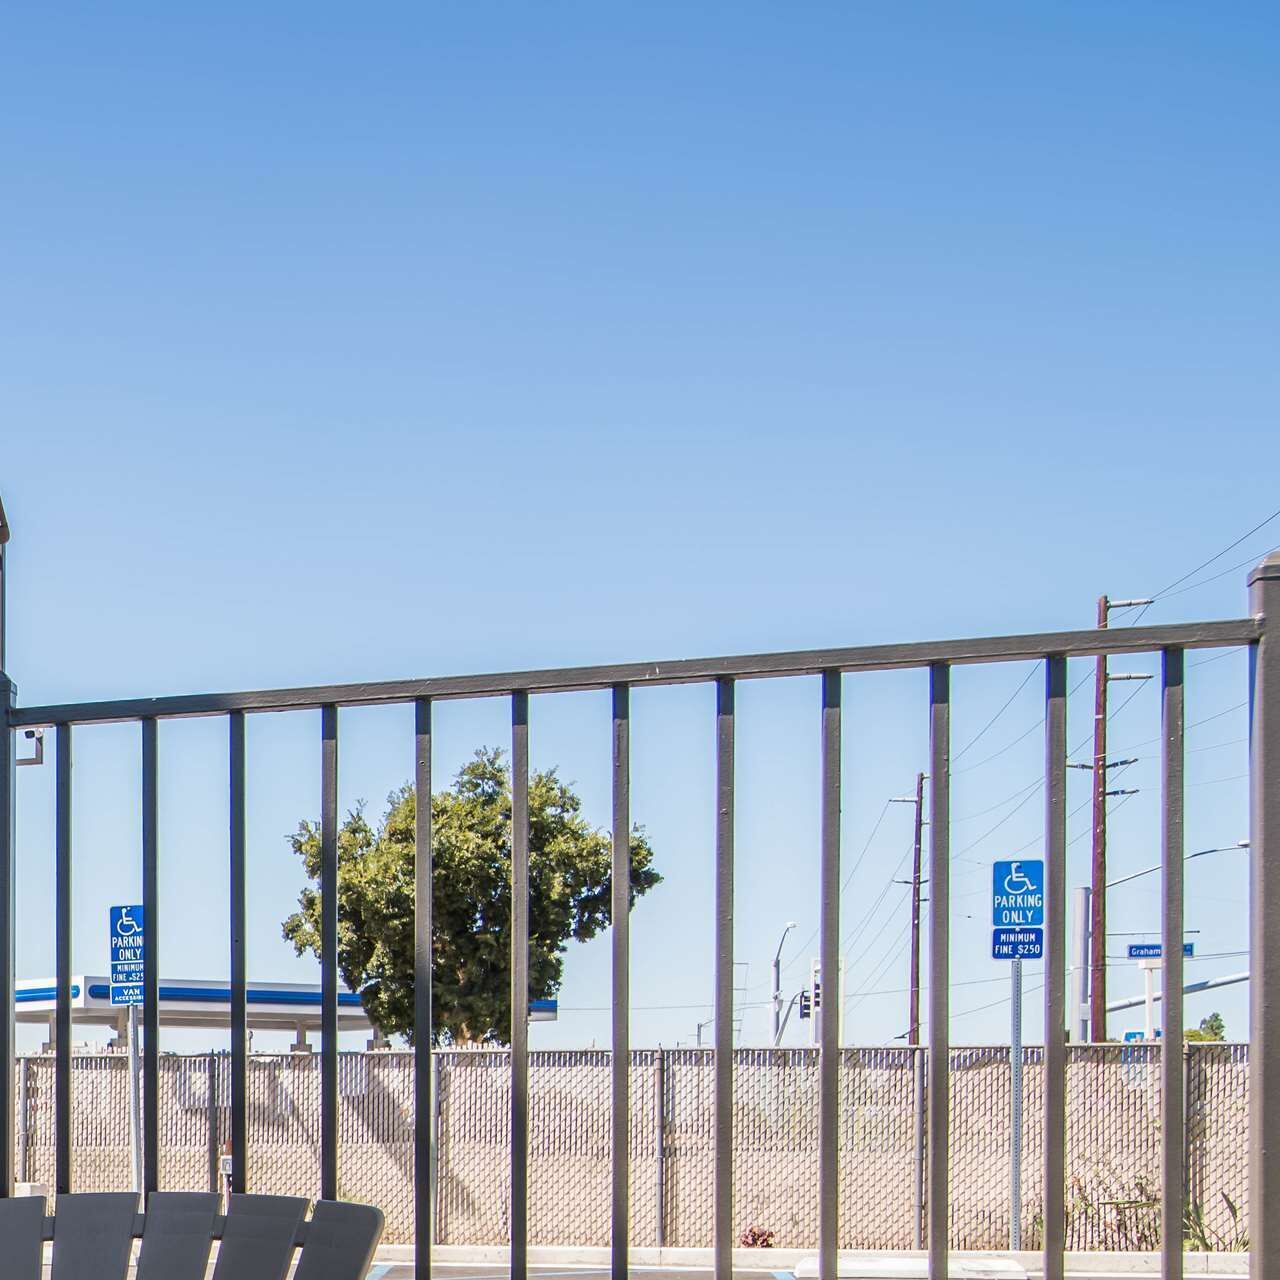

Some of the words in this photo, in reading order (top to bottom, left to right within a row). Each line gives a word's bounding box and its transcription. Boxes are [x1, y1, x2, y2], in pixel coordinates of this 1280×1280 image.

[994, 894, 1042, 908] PARKING
[1002, 910, 1033, 923] ONLY
[112, 935, 143, 948] PARKIN
[1000, 933, 1036, 943] MINIMUM
[119, 948, 141, 960] ONLY
[995, 945, 1013, 954] FINE
[112, 973, 126, 981] FINE
[131, 972, 144, 981] $25
[123, 988, 140, 996] VAN
